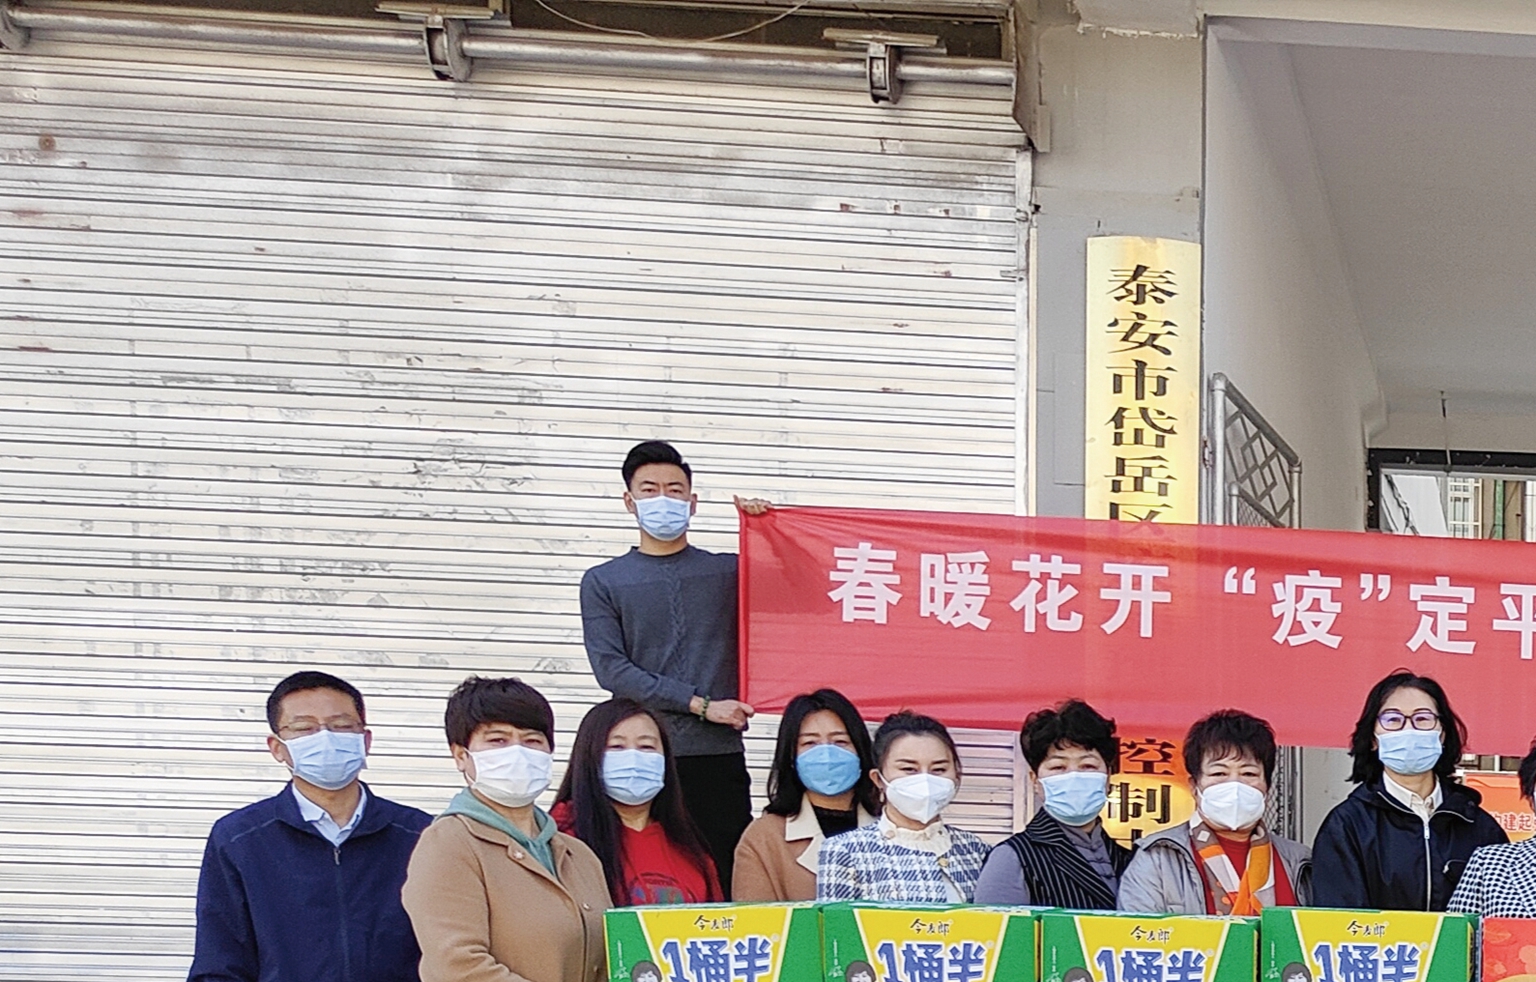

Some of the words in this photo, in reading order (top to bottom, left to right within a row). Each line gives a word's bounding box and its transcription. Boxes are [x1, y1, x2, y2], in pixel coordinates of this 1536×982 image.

[828, 541, 1171, 638] 春暖花开
[1108, 738, 1176, 848] 控制
